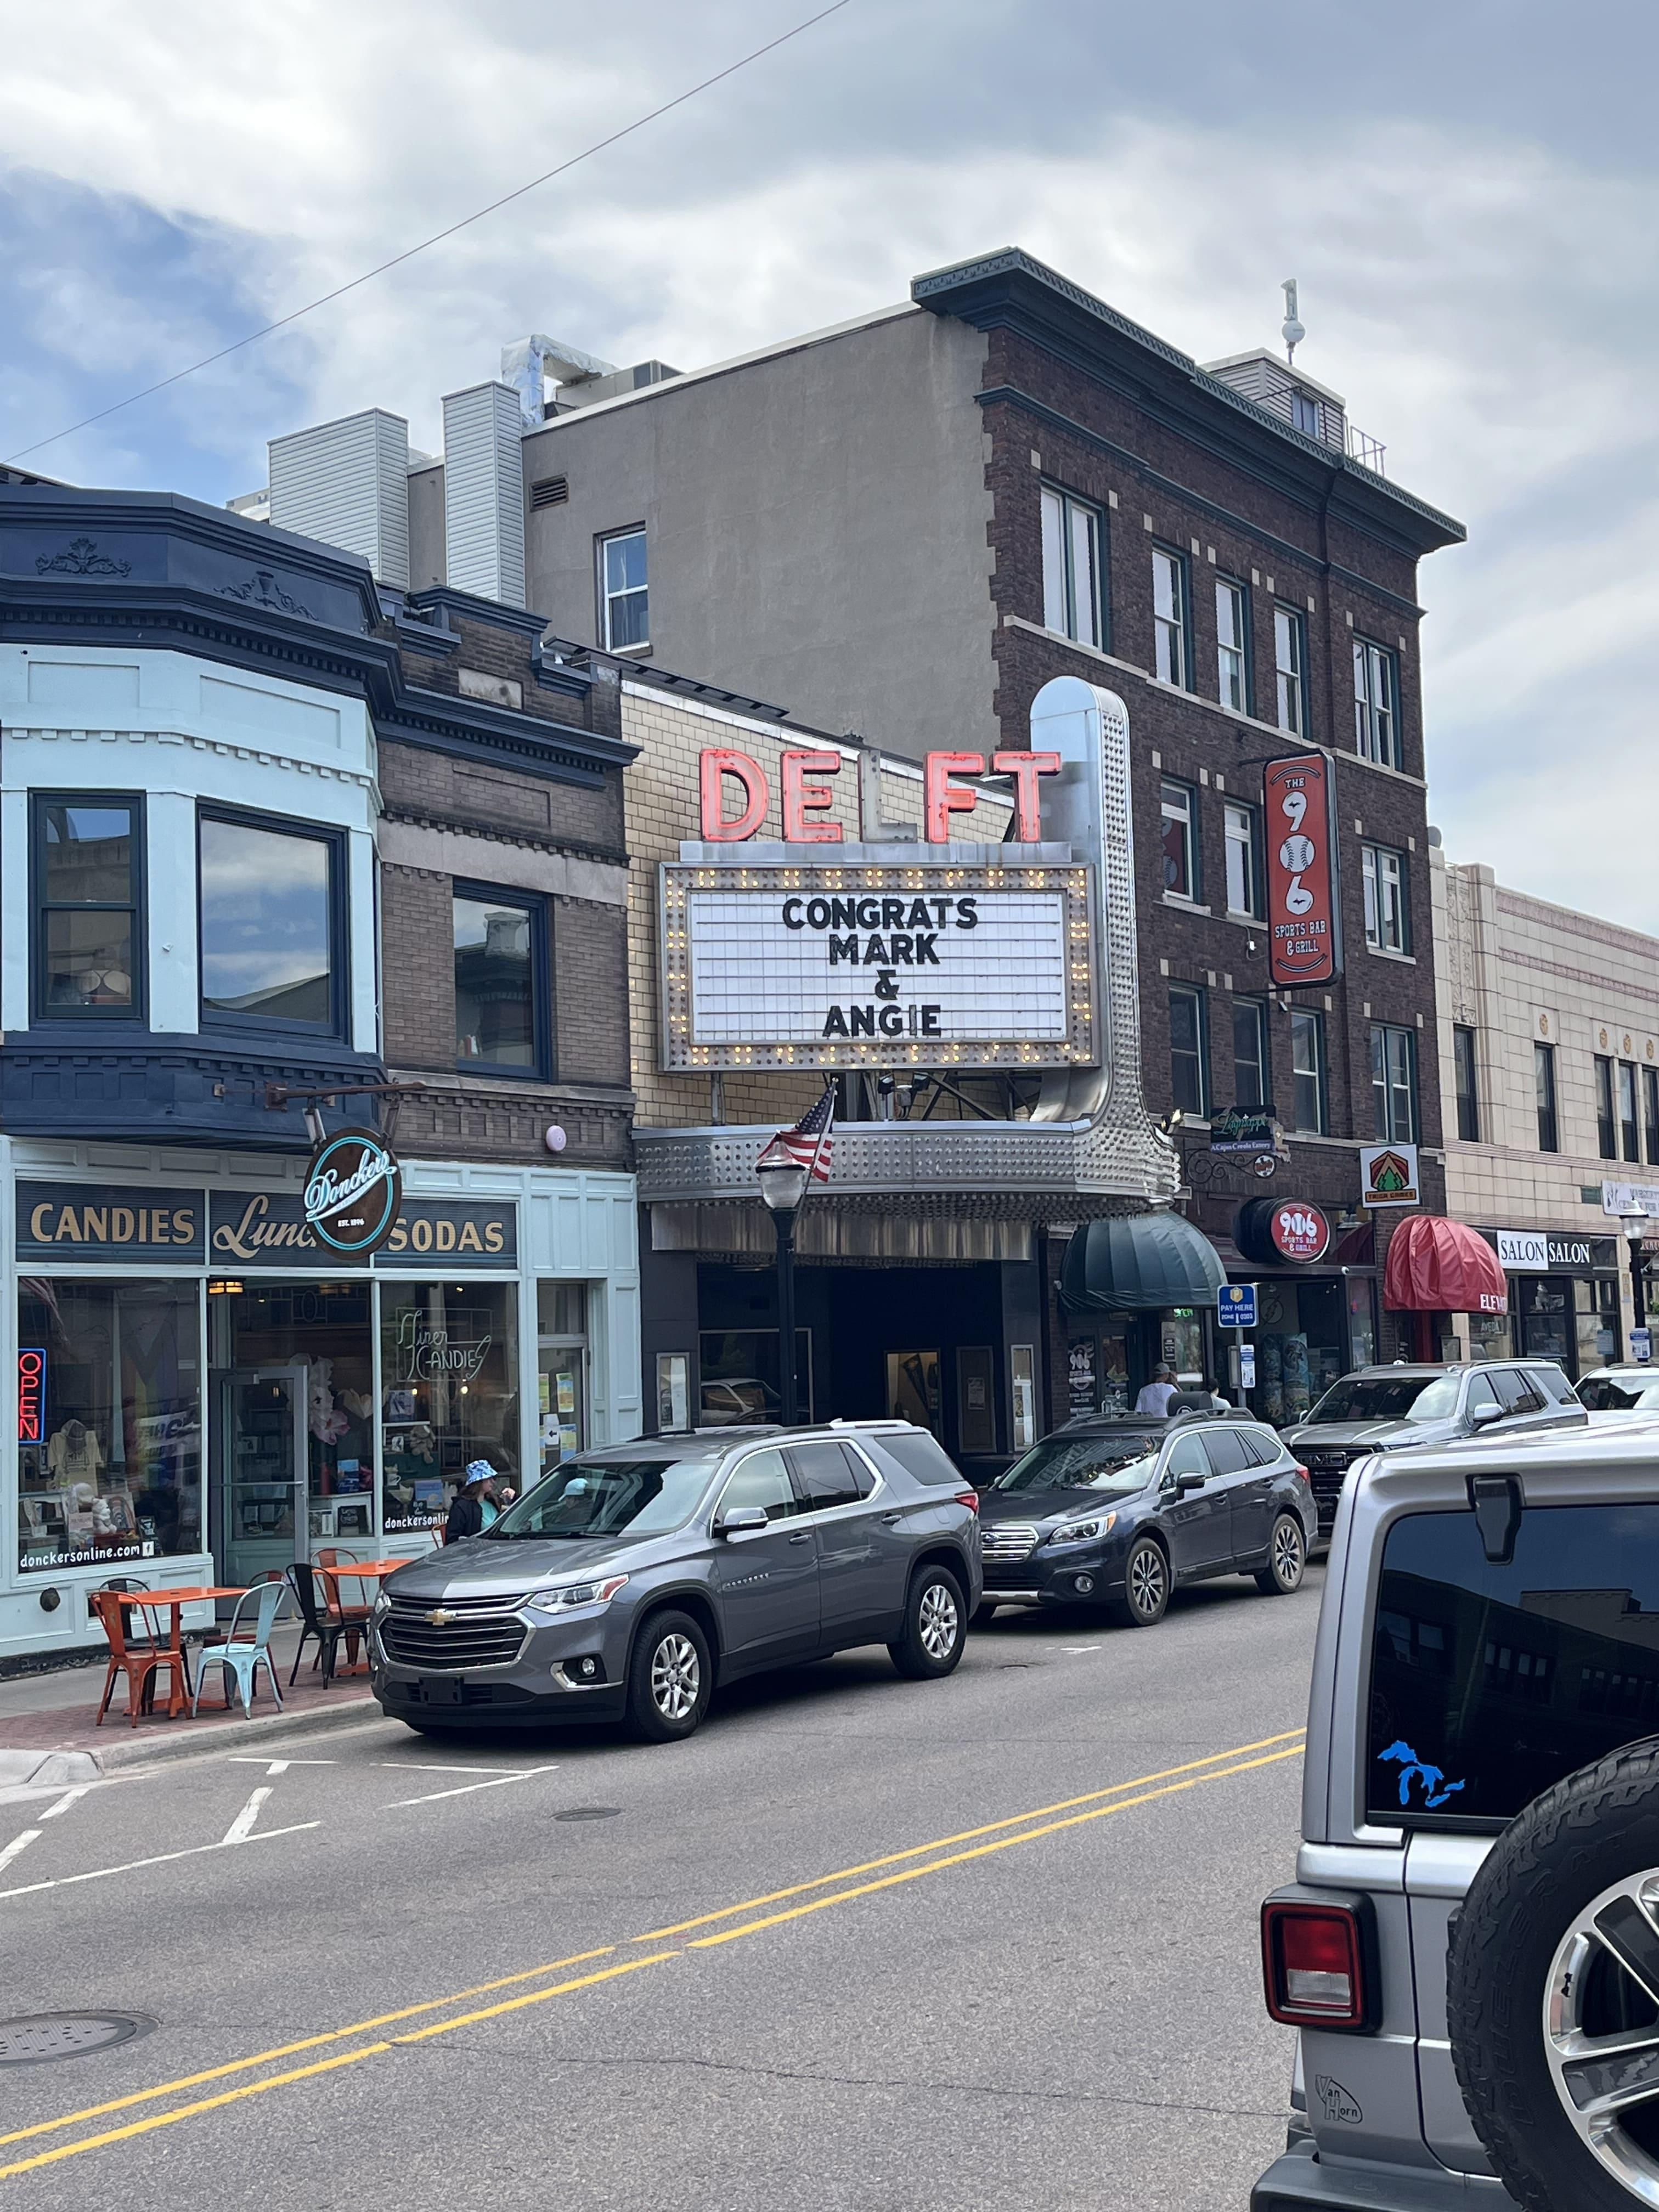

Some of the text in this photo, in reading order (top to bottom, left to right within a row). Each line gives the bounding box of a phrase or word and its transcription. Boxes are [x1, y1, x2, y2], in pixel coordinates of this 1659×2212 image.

[699, 749, 1062, 843] DELFT
[1285, 777, 1305, 788] THE
[782, 898, 978, 930] CONGRATS
[1275, 920, 1326, 939] SPORTS BAR
[829, 934, 941, 965] MARK
[1286, 940, 1319, 956] & GRILL
[874, 969, 899, 1000] &
[822, 1005, 941, 1037] ANGIE
[31, 1203, 195, 1244] CANDIES
[212, 1195, 317, 1259] Lunc
[387, 1218, 504, 1252] SODAS
[1280, 1211, 1317, 1237] 906
[1501, 1240, 1544, 1261] SALON
[1549, 1242, 1590, 1263] SALON
[19, 1353, 42, 1440] OPEN
[20, 1544, 140, 1567] donckersonline.com
[1315, 2074, 1340, 2099] Van
[1324, 2097, 1358, 2121] Horn
